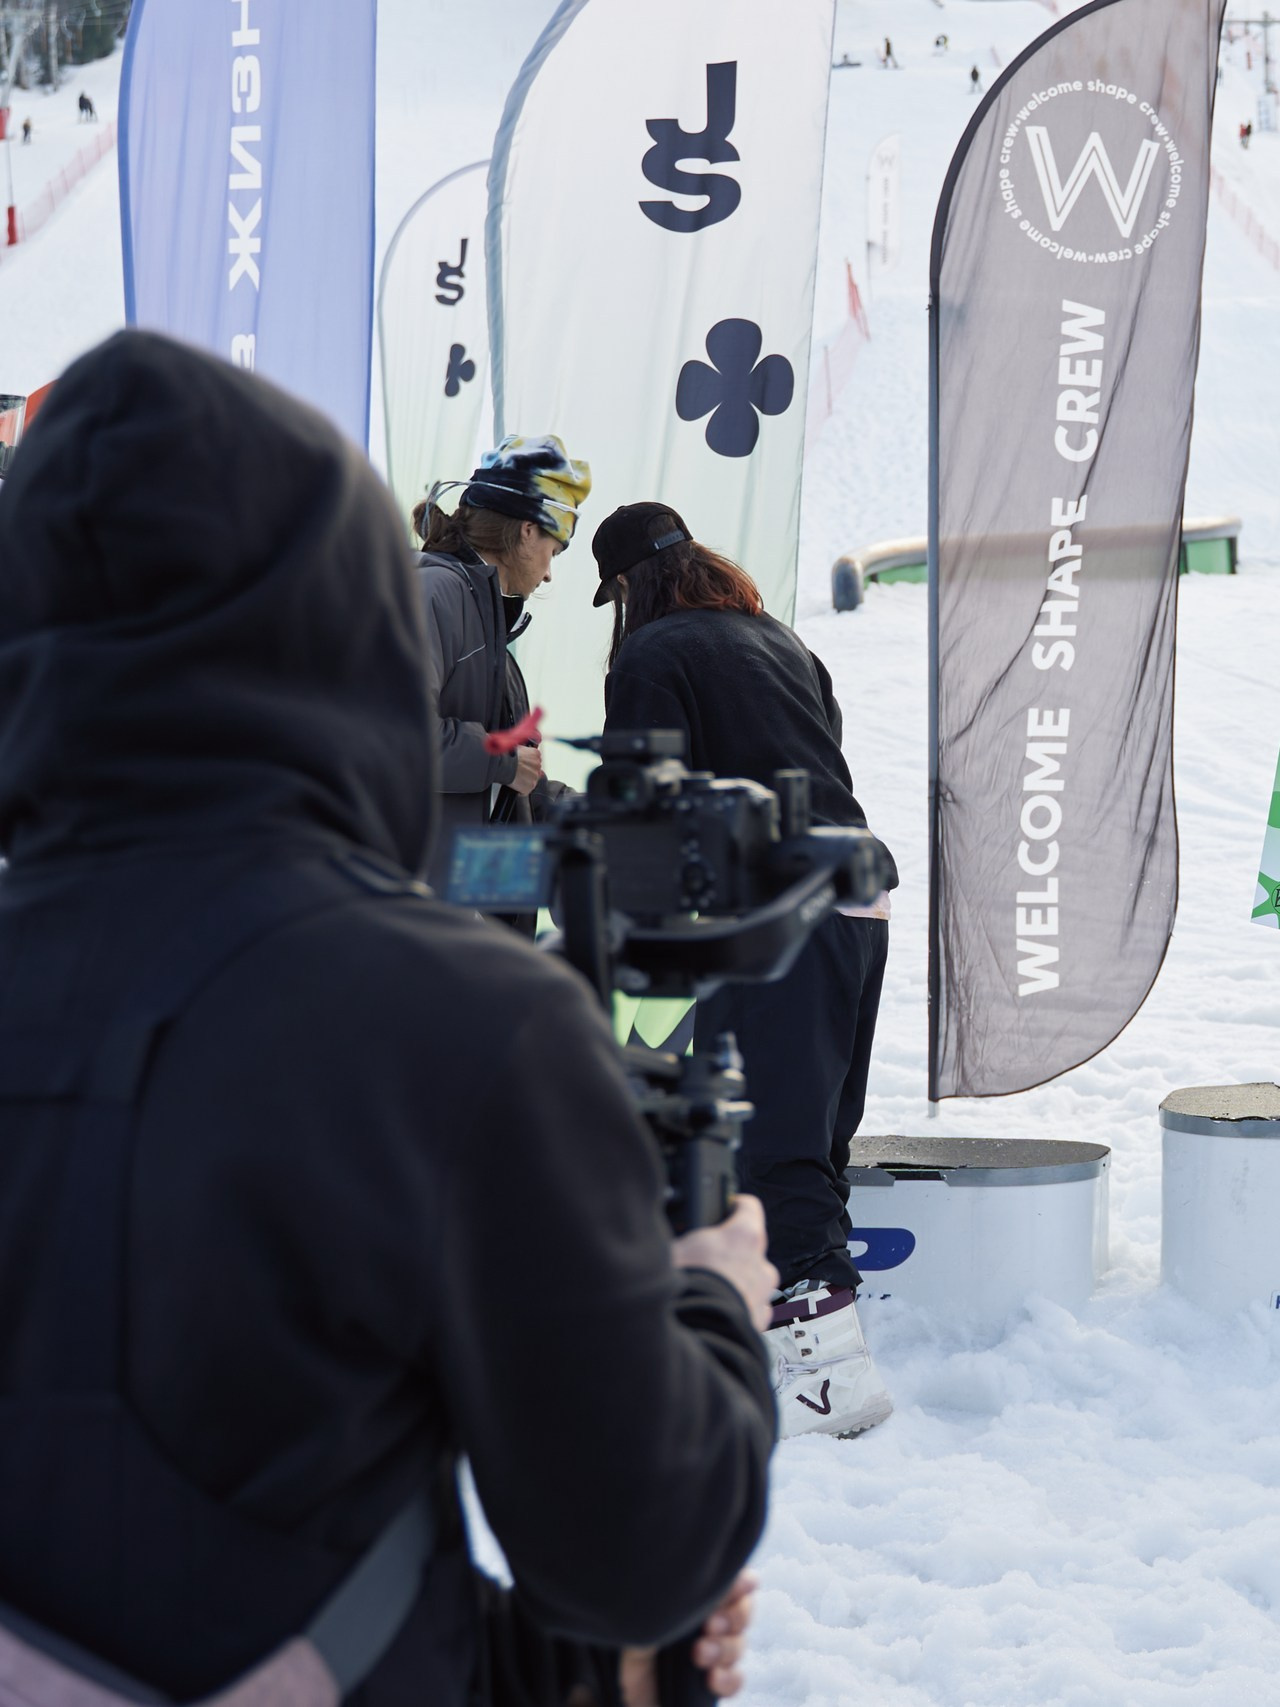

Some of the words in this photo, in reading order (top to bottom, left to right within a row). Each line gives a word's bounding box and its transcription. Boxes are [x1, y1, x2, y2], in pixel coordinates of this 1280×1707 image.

[1016, 80, 1083, 121] welcome
[1087, 78, 1137, 104] shape
[999, 168, 1022, 219] shape
[1019, 219, 1087, 263] welcome
[1134, 210, 1171, 254] shape
[1054, 298, 1106, 463] CREW
[1031, 493, 1088, 672] SHAPE
[1015, 707, 1071, 997] WELCOME
